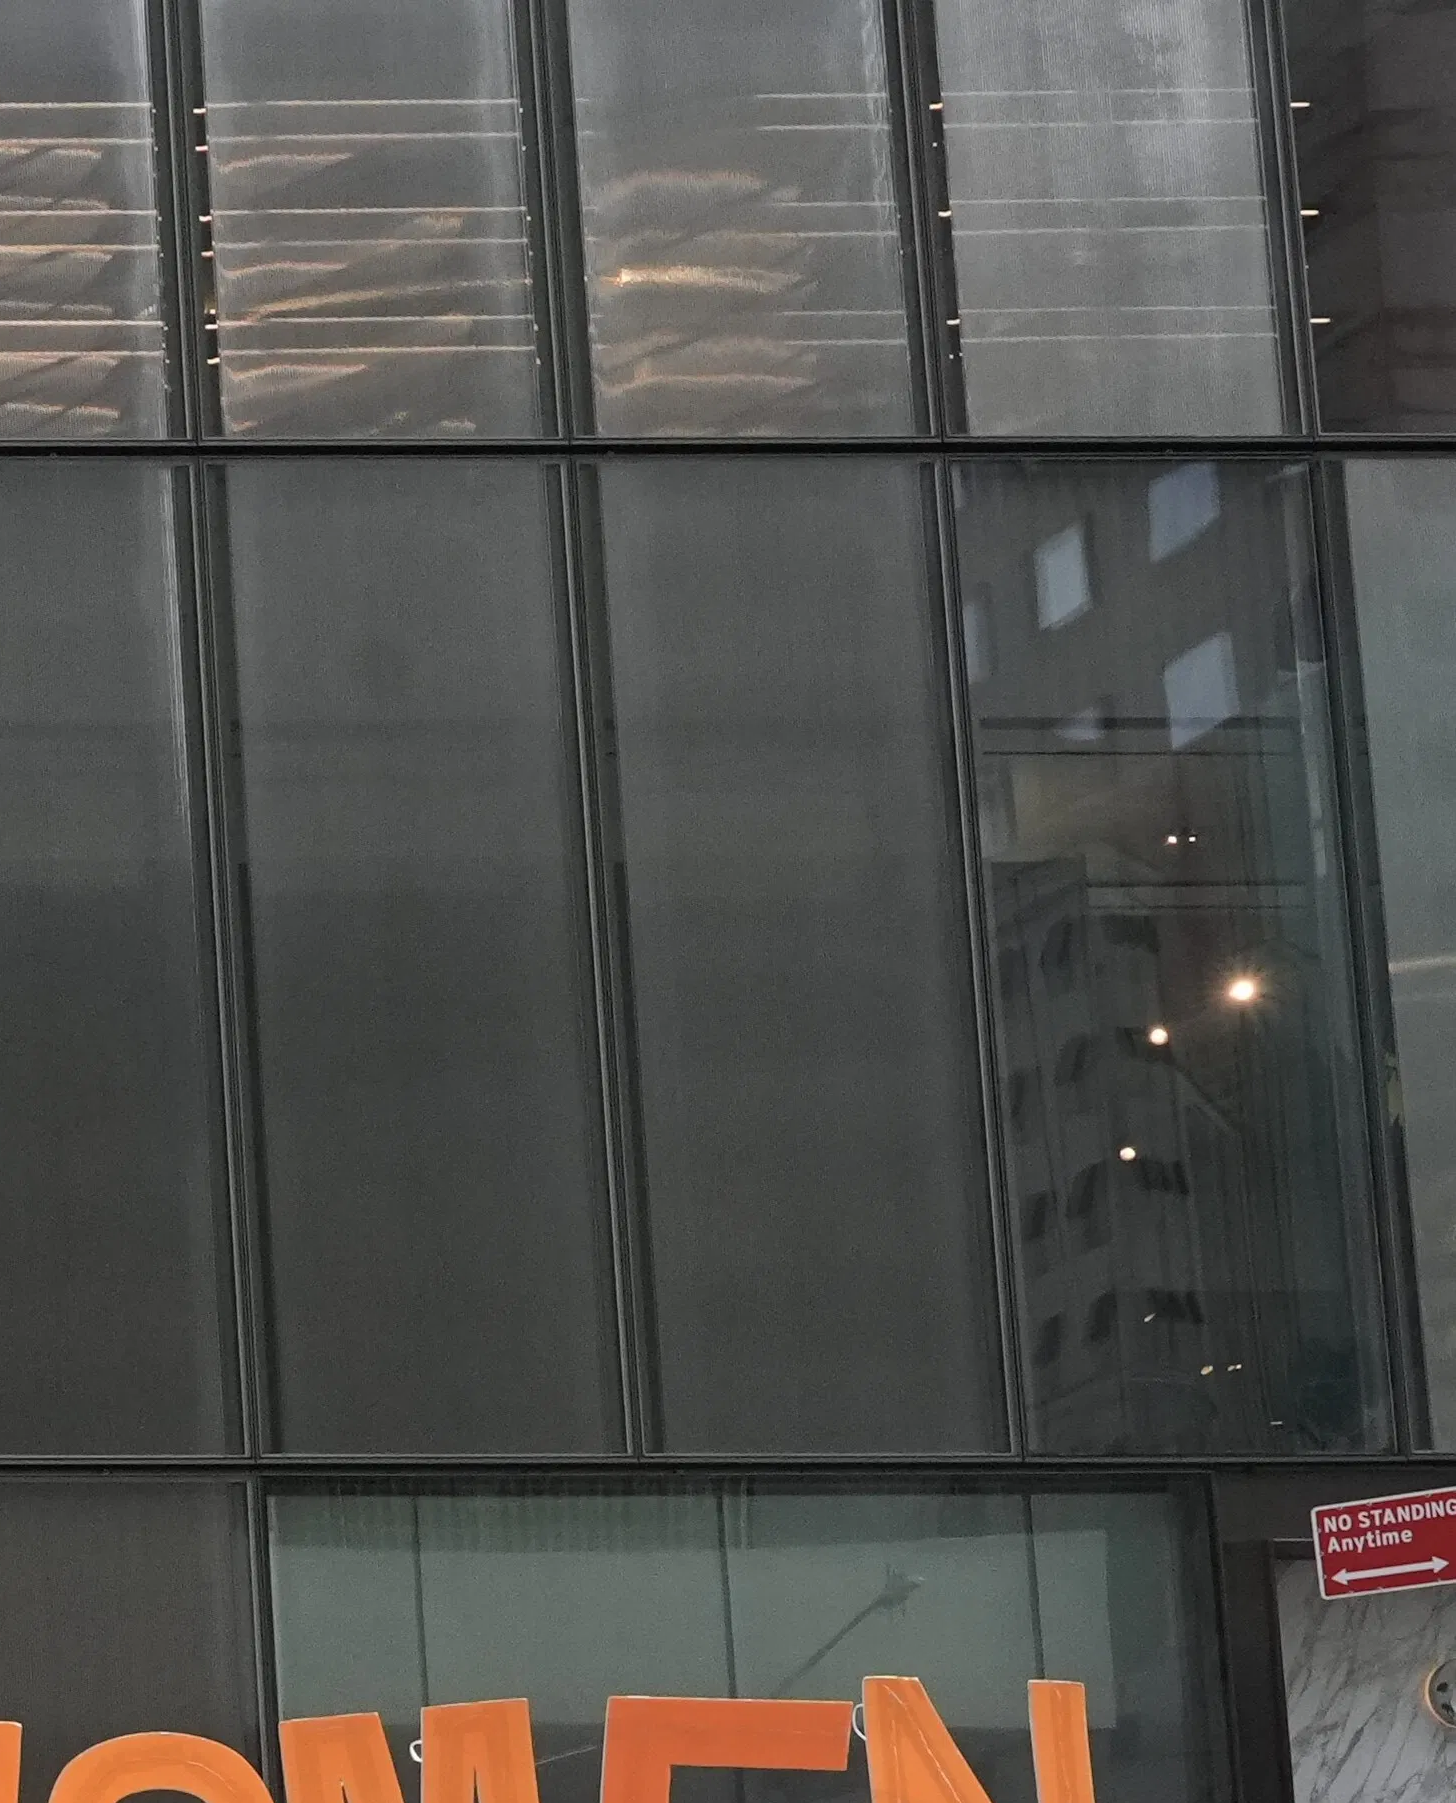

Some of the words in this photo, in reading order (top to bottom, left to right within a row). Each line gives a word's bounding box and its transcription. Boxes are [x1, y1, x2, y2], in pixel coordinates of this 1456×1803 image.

[1323, 1513, 1352, 1533] NO
[1358, 1498, 1456, 1529] STANDING
[1327, 1529, 1413, 1554] Anytime
